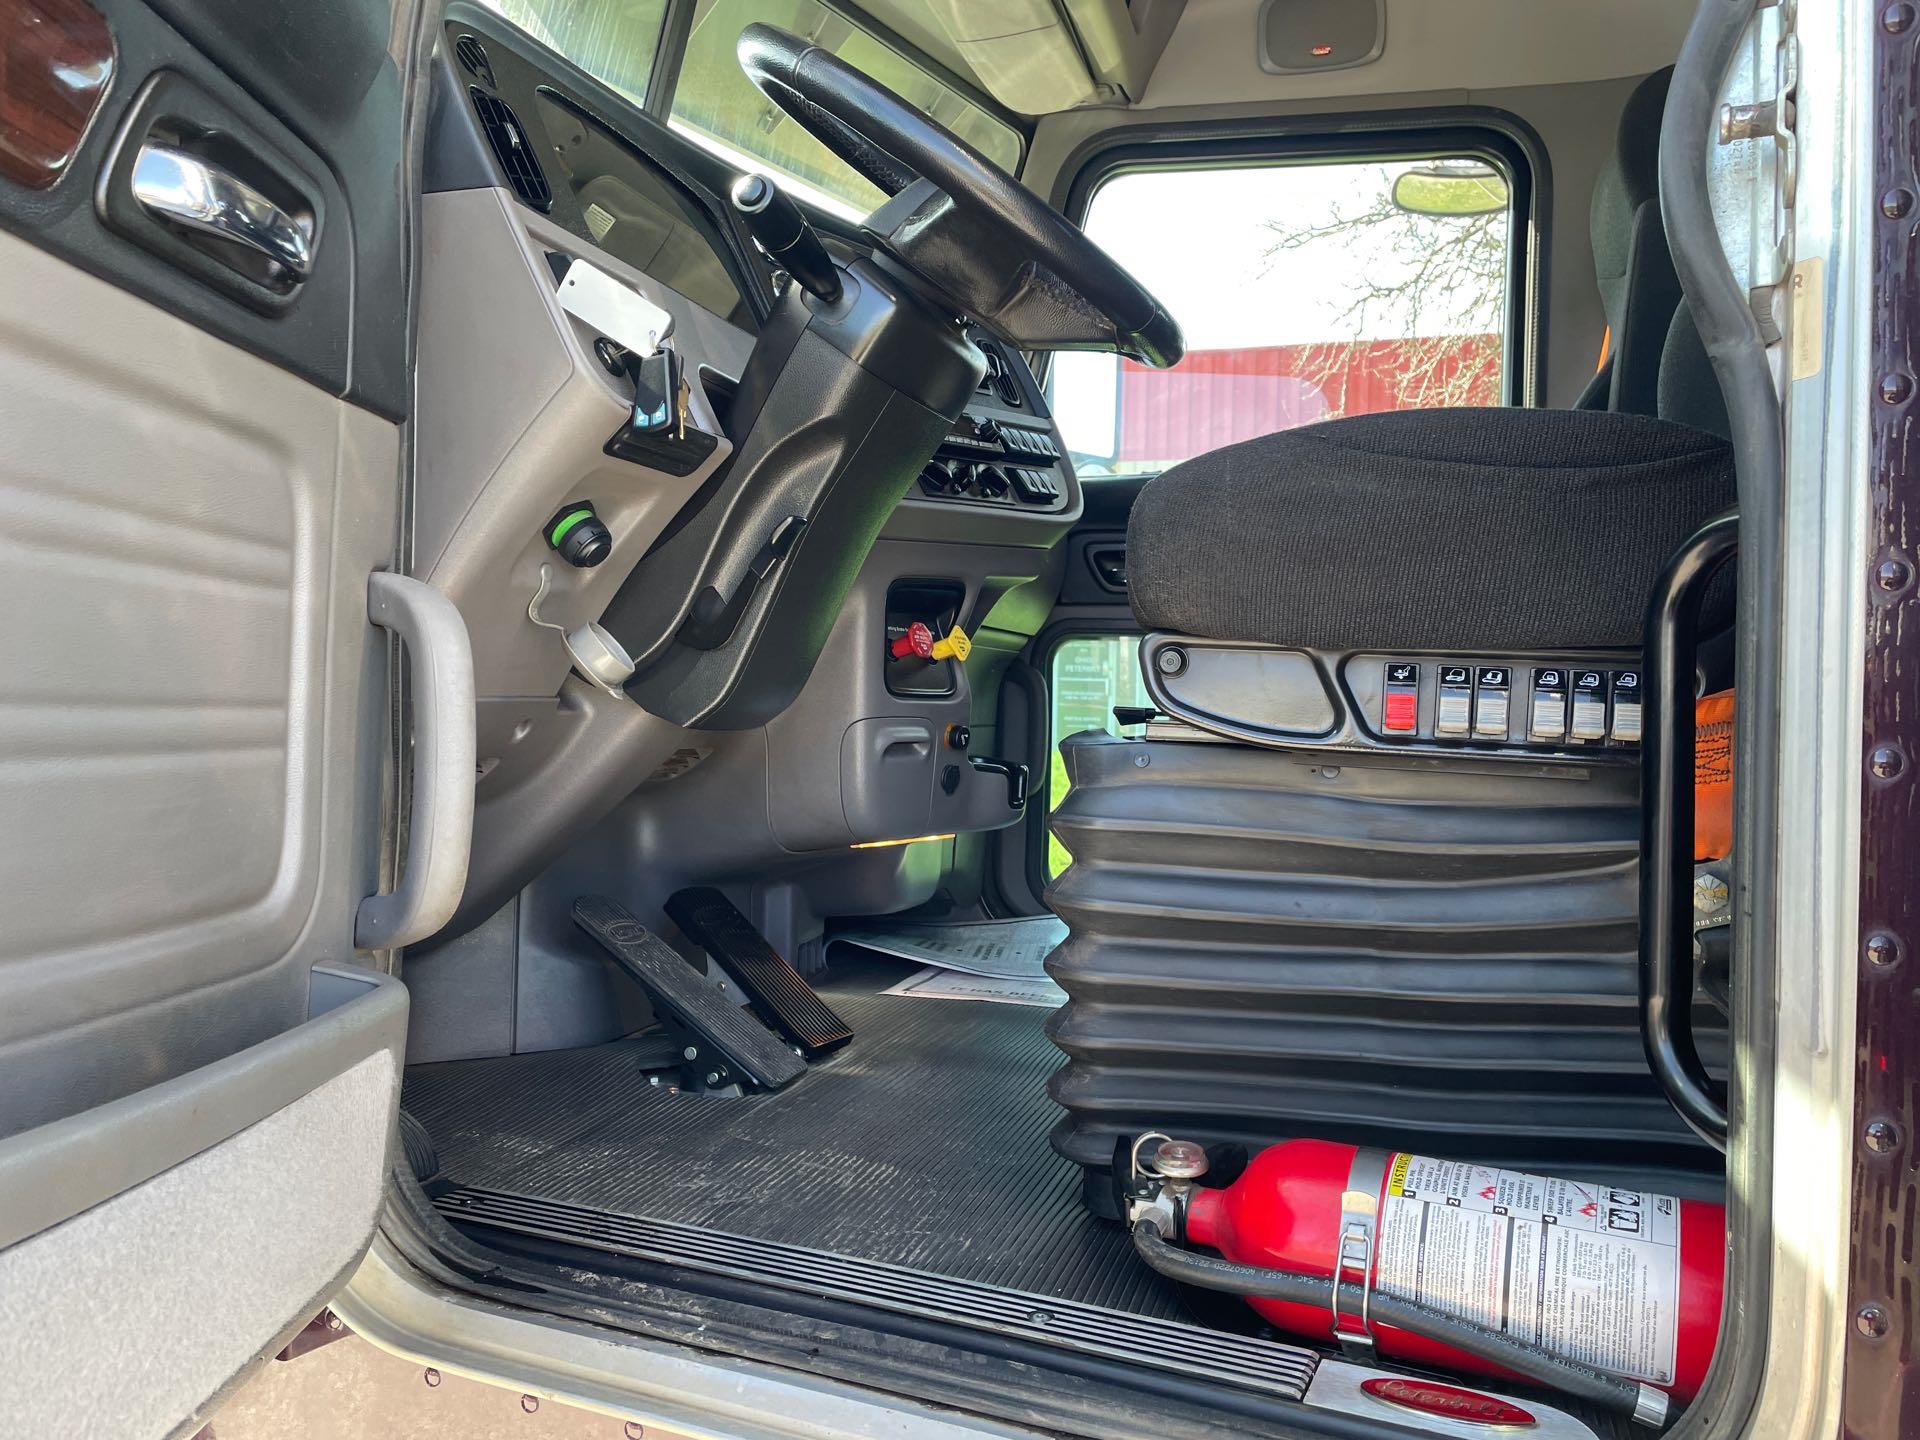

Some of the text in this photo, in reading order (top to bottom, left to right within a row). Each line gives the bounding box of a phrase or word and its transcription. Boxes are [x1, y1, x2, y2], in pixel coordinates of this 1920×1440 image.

[1544, 1215, 1554, 1223] 4
[1261, 1270, 1292, 1280] (-65F)
[1323, 1279, 1345, 1290] PIG
[1395, 1298, 1418, 1312] MAX.
[1422, 1307, 1446, 1321] 2052
[1450, 1317, 1479, 1333] ISSUE
[1524, 1346, 1549, 1360] HOSE
[1553, 1356, 1595, 1377] BOOSTER
[1615, 1380, 1637, 1394] EXT.
[1379, 1380, 1507, 1418] Peterbilt
